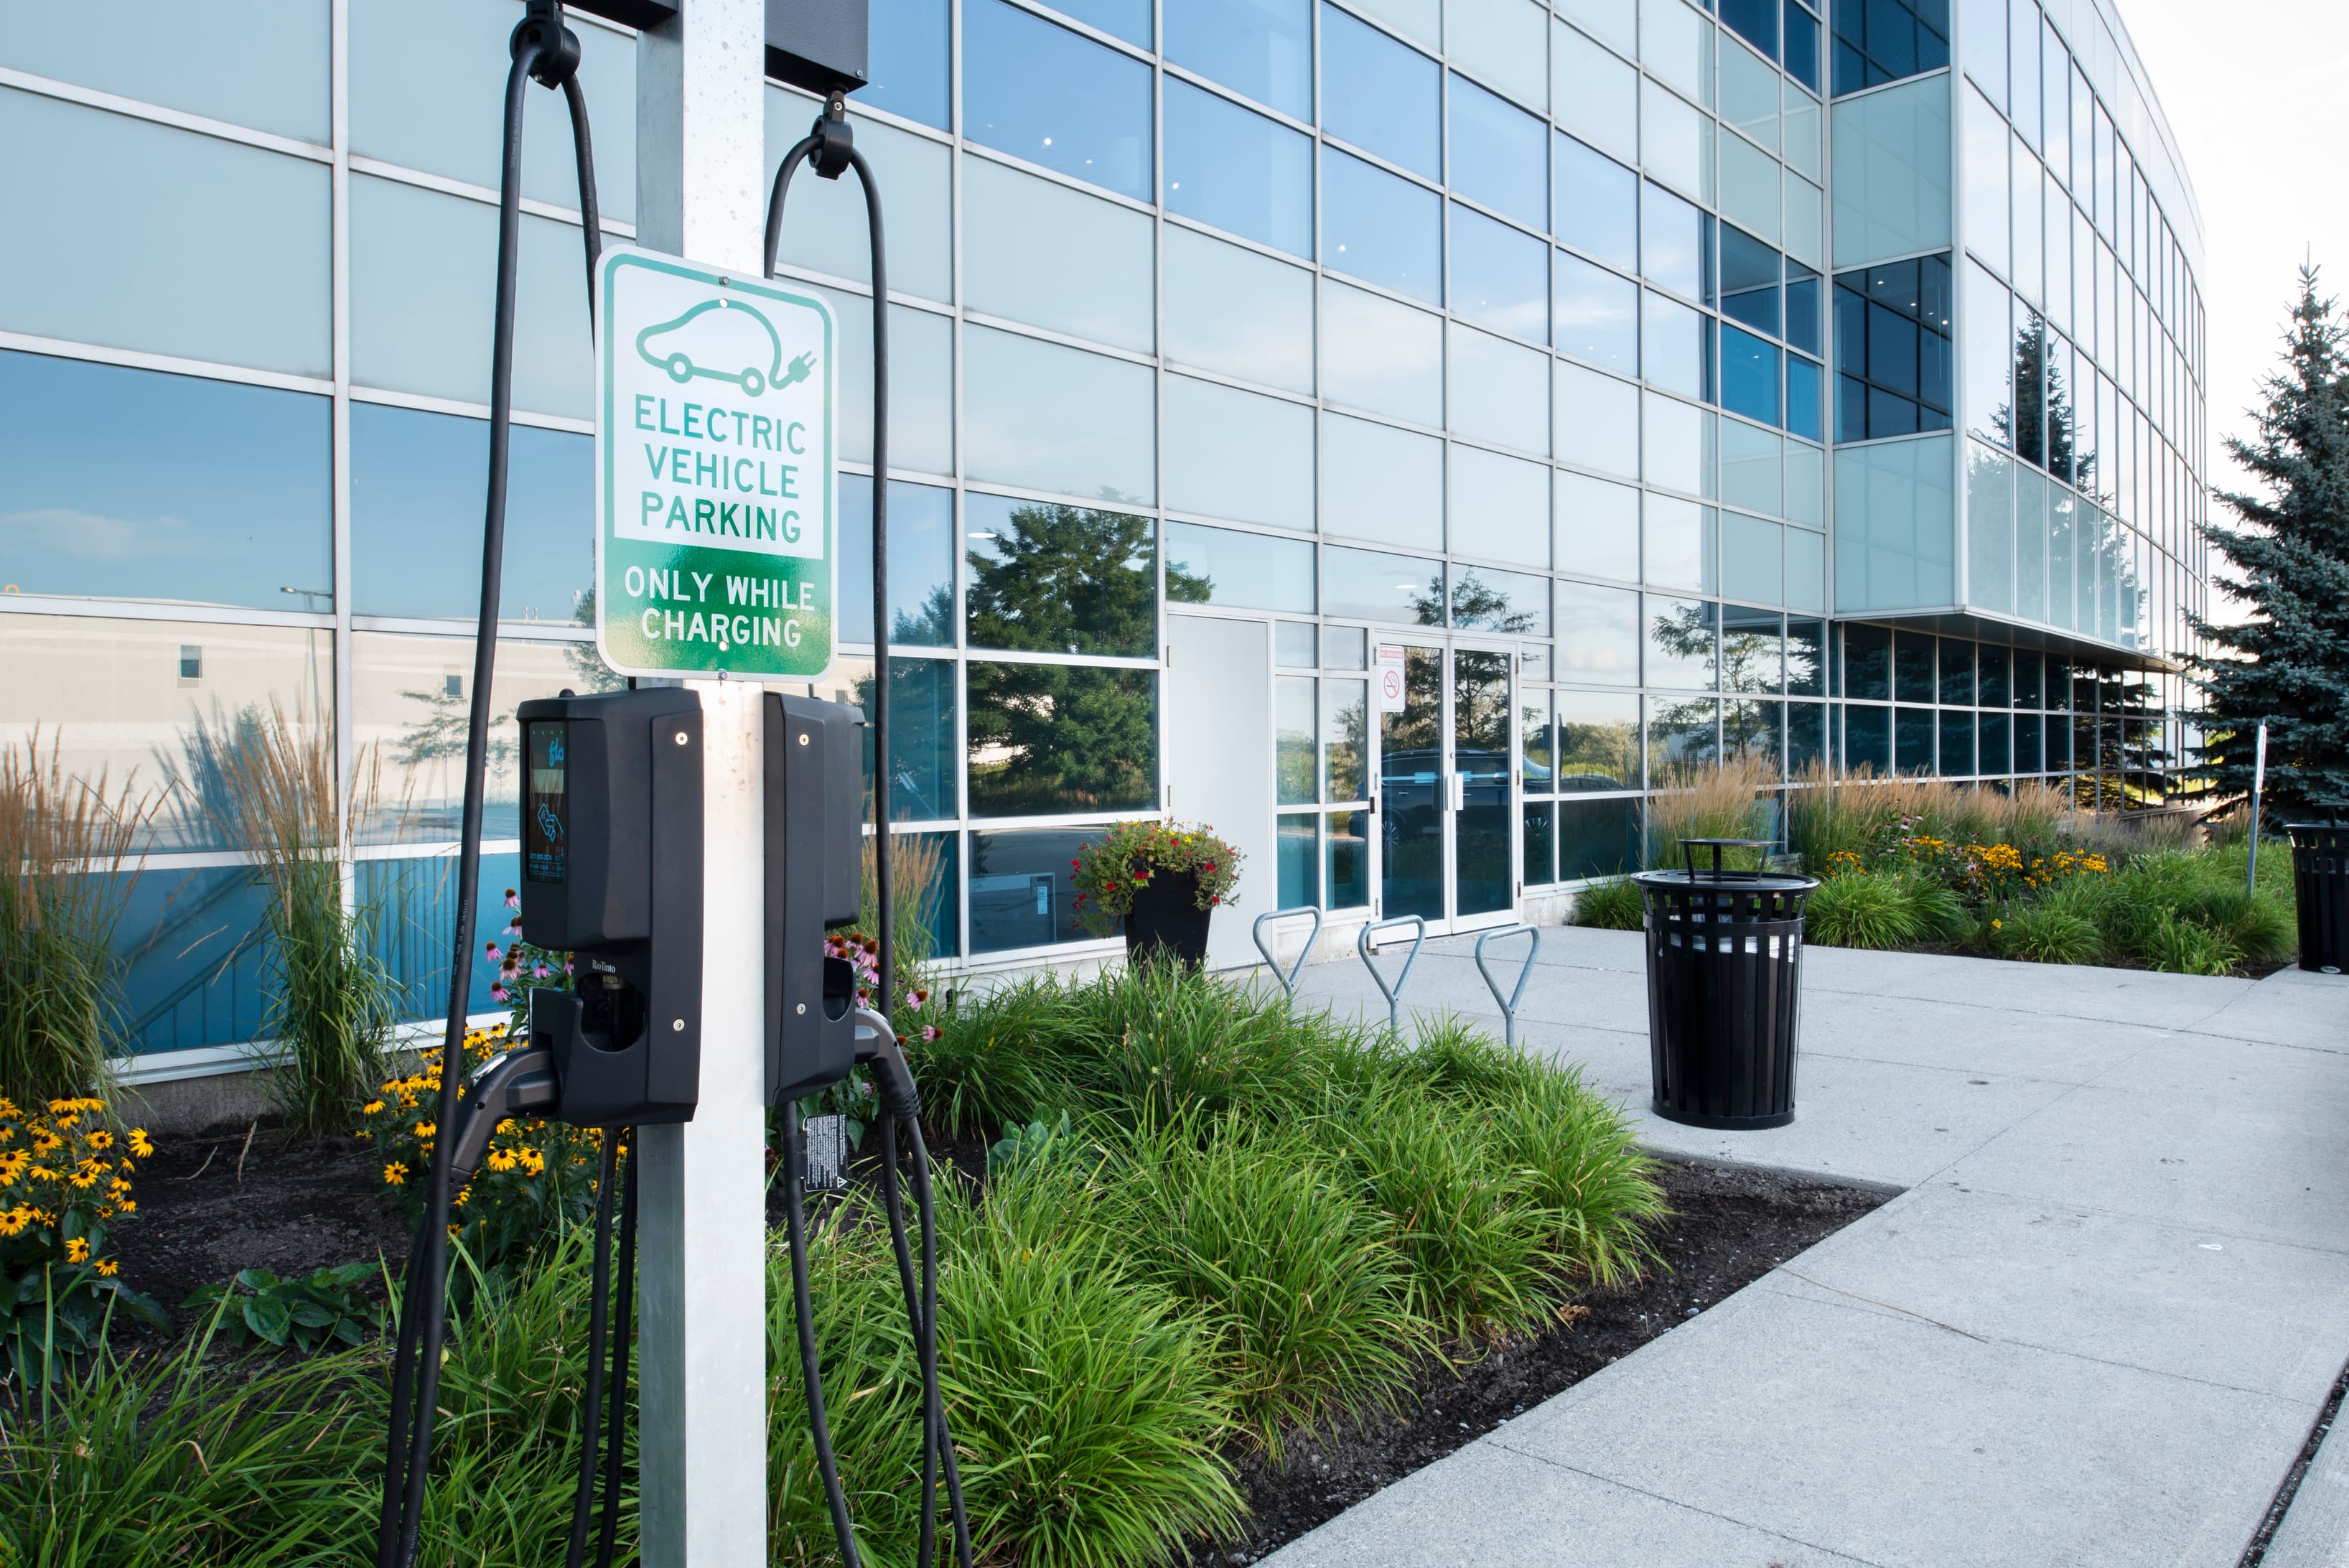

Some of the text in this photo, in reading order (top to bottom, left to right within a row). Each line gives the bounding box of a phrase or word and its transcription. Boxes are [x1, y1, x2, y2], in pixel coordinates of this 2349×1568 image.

[635, 393, 805, 455] ELECTRIC
[644, 443, 799, 499] VEHICLE
[642, 491, 800, 543] PARKING
[625, 566, 815, 611] ONLY WHILE
[642, 608, 800, 647] CHARGING
